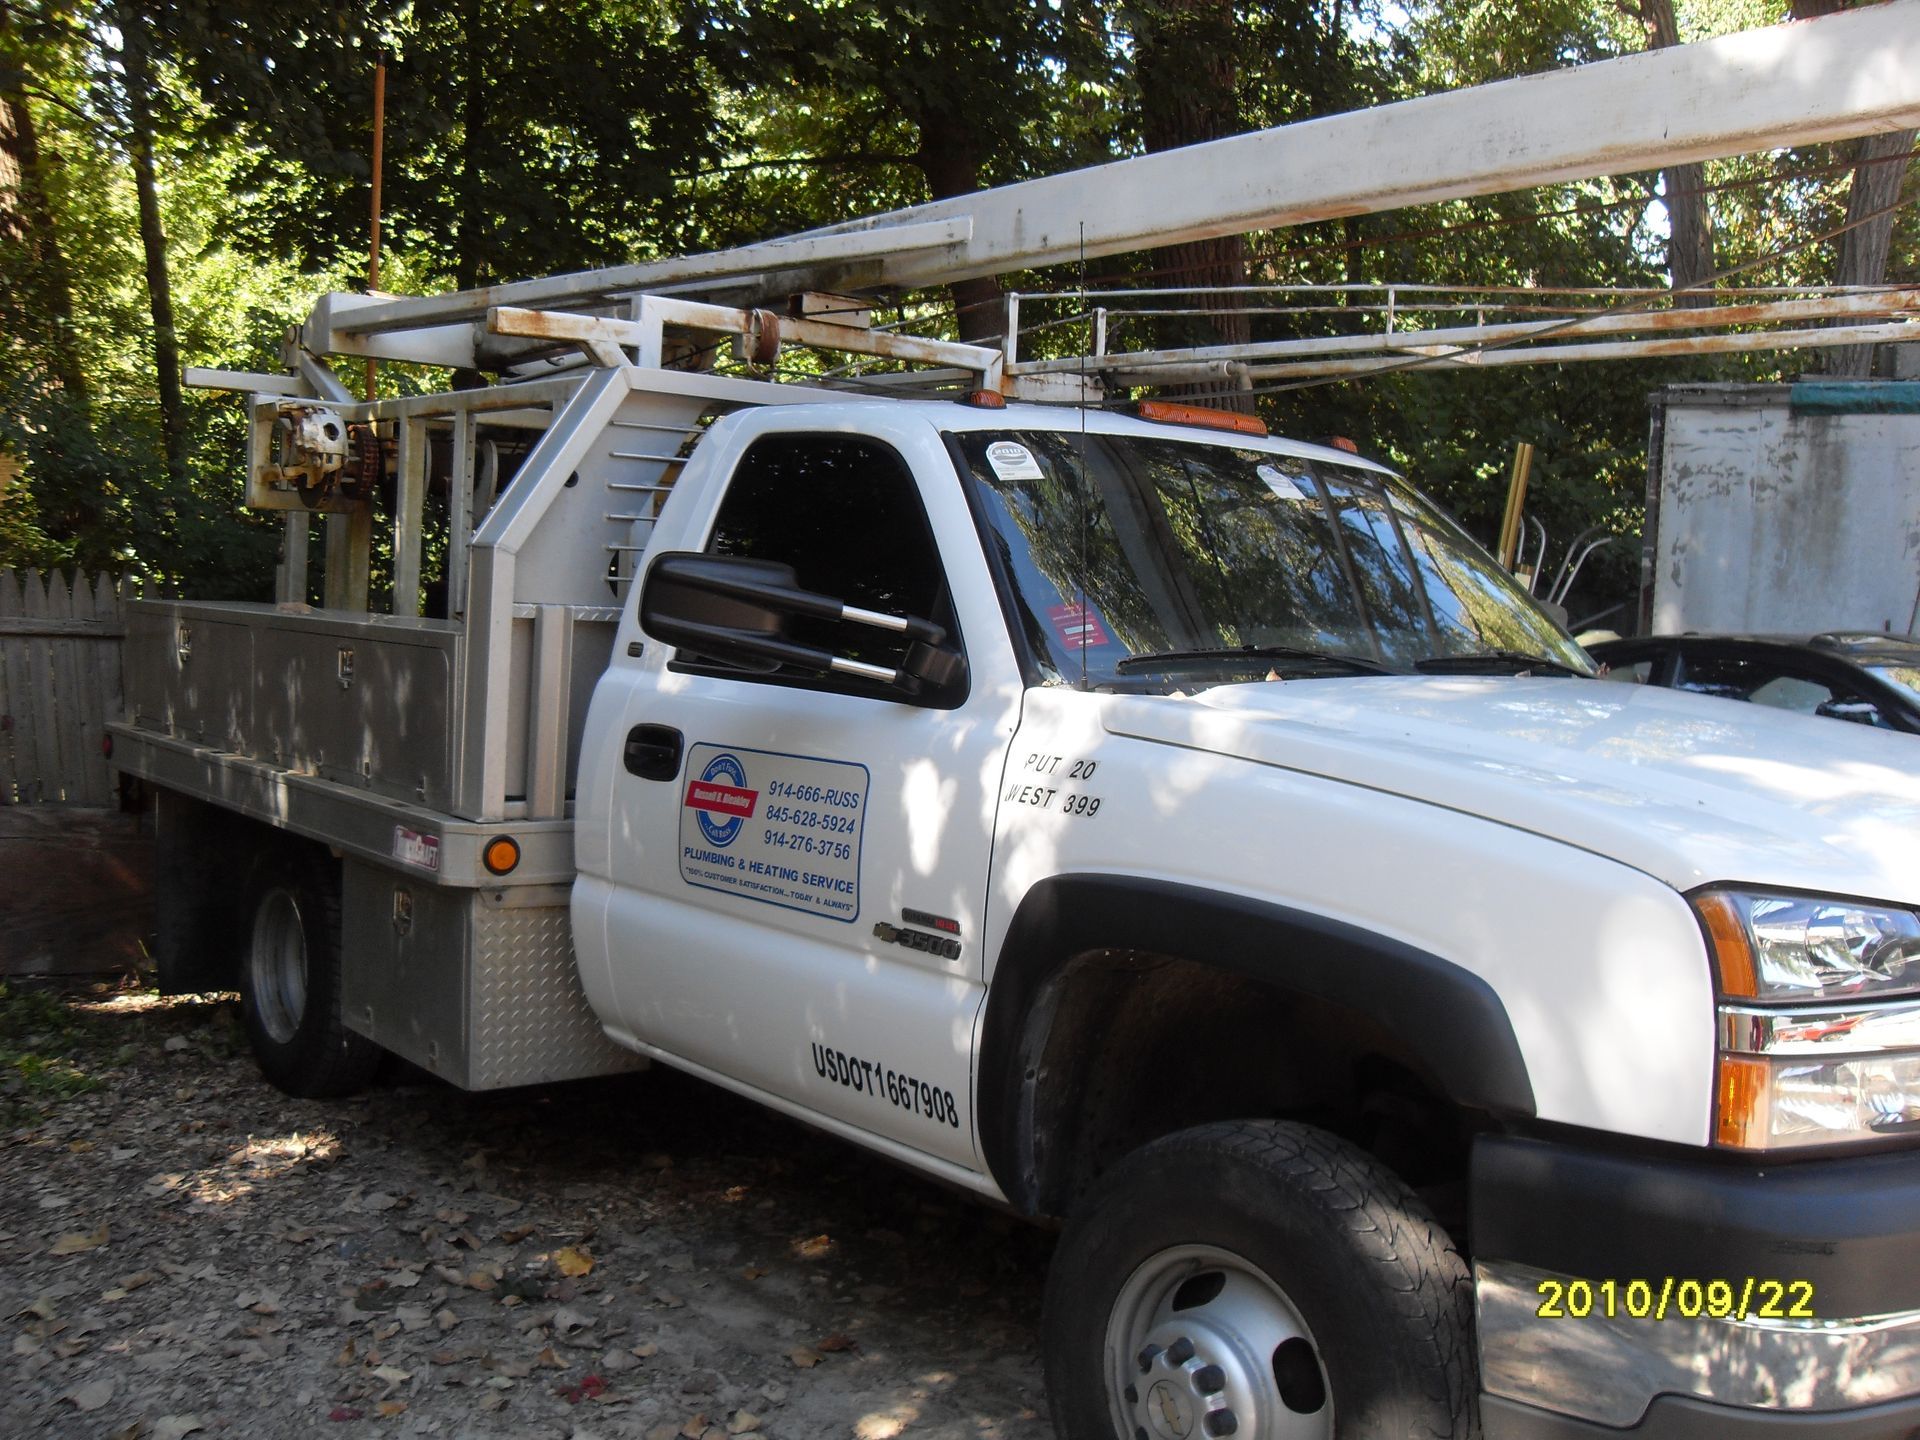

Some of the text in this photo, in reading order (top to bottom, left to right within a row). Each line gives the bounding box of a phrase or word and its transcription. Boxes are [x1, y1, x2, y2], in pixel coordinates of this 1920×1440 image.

[1024, 753, 1096, 780] PUT 20
[768, 780, 860, 809] 914-666-RUSS
[1004, 783, 1101, 817] WEST 399
[766, 805, 856, 834] 845-628-5924
[764, 830, 851, 860] 914-276-3756
[684, 846, 854, 894] PLUMBING & HEATING SERVICE
[704, 871, 737, 886] CUSTOMER
[815, 896, 821, 905] &
[899, 928, 962, 961] 3500
[812, 1042, 960, 1129] USDOT1667908
